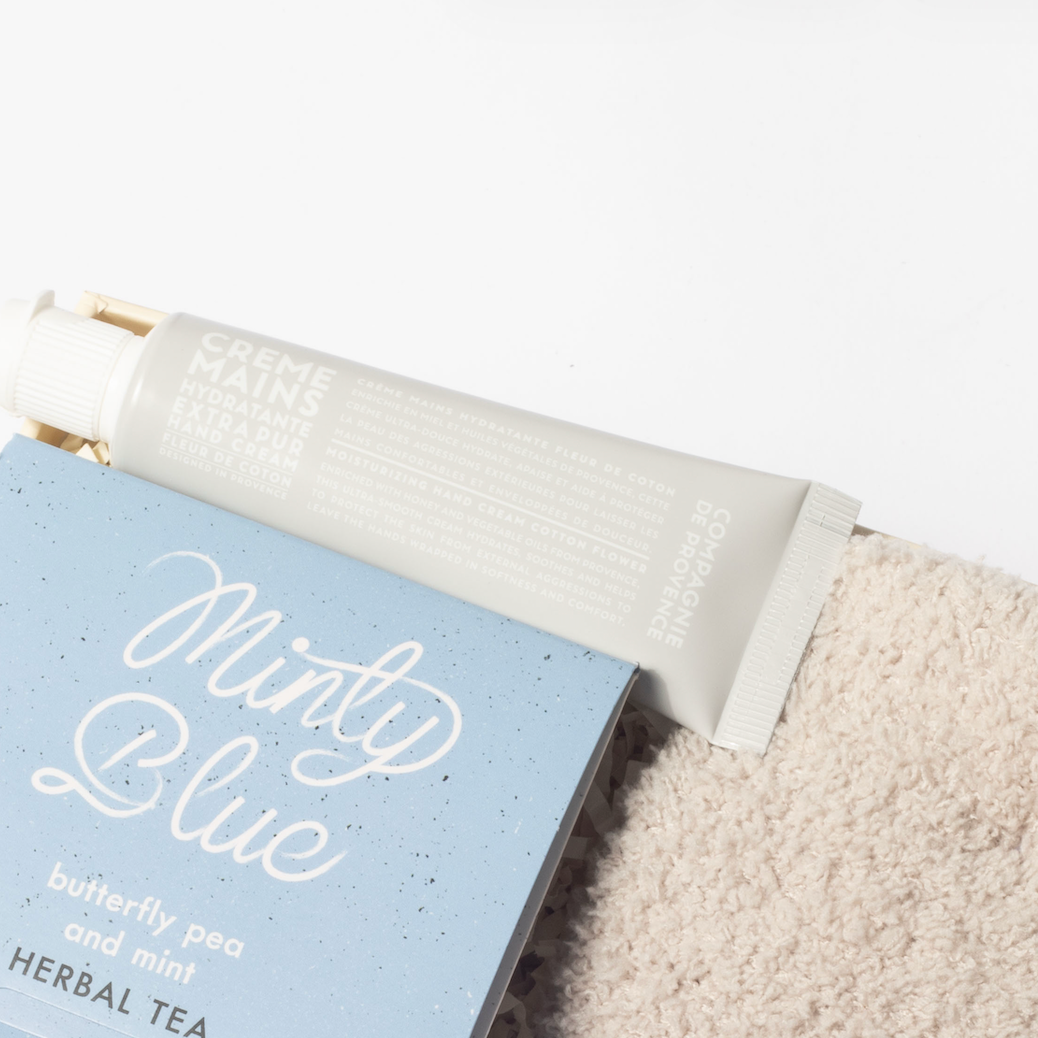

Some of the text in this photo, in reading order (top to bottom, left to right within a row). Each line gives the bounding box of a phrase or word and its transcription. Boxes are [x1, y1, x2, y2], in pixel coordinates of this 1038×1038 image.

[179, 377, 313, 437] HYDRATANTE
[187, 349, 324, 416] MAINS
[201, 331, 337, 390] CREME
[158, 446, 287, 500] DESIGNED IN PROVENCE
[161, 431, 292, 488] FLEUR DE COTON
[166, 413, 299, 472] HAND CREAM
[171, 395, 303, 456] EXTRA PUR
[339, 413, 659, 539] LA PEAU DES AGRESSIONS EXTÉRIEURES POUR LAISSER LES
[345, 400, 664, 524] CRÈME ULTRA-DOUCE HYDRATE, APAISE ET AIDE À PROTÉGER
[350, 387, 670, 511] ENRICHIE EN MIEL ET HUILES VÉGÉTALES DE PROVENCE, CETTE
[356, 377, 675, 497] CRÈME MAINS HYDRATANTE FLEUR DE COTON
[311, 487, 631, 613] TO PROTECT THE SKIN FROM EXTERNAL AGGRESSIONS TO
[315, 474, 636, 600] THIS ULTRA-SMOOTH CREAM HYDRATES, SOOTHES AND HELPS
[320, 461, 640, 589] ENRICHED WITH HONEY AND VEGETABLE OILS FROM PROVENCE,
[325, 446, 647, 574] MOISTURIZING HAND CREAM COTTON FLOWER
[333, 427, 651, 553] MAINS CONFORTABLES ET ENVELOPPÉES DE DOUCEUR.
[306, 500, 625, 627] LEAVE THE HANDS WRAPPED IN SOFTNESS AND COMFORT.
[646, 499, 713, 641] DE PROVENCE
[665, 508, 731, 649] COMPAGNIE
[123, 550, 462, 786] Minty
[31, 692, 347, 882] Blue
[47, 861, 245, 959] butterfly pea
[64, 922, 196, 984] and mint
[8, 946, 131, 1015] HERBAL
